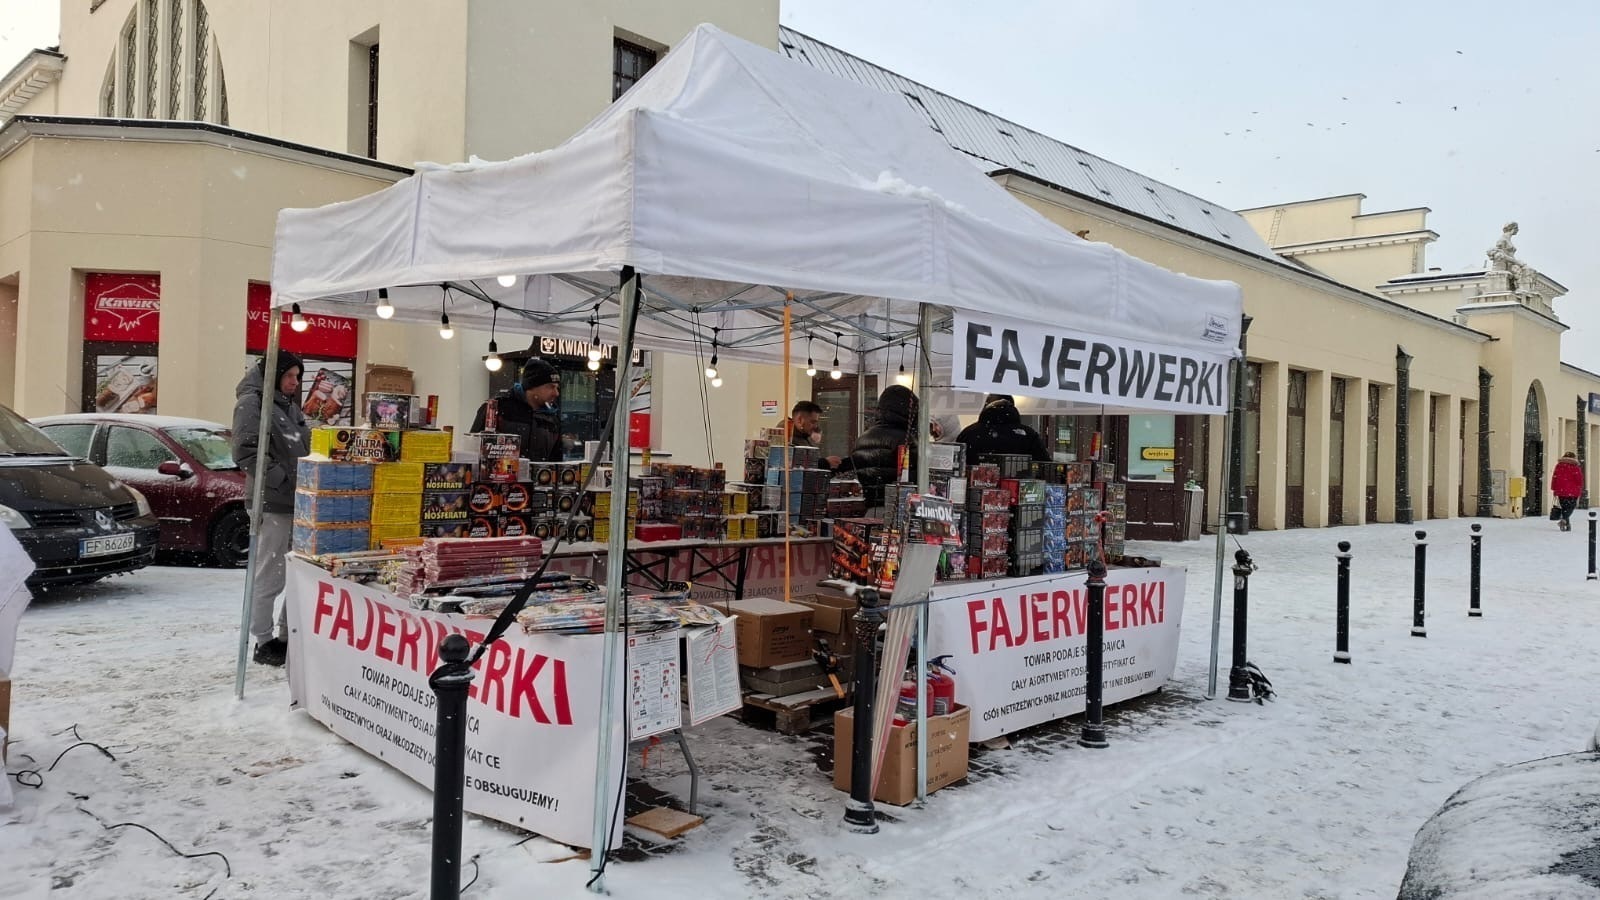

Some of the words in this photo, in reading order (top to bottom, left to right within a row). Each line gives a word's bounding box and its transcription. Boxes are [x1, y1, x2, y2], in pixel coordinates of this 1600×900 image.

[965, 321, 1222, 407] FAJERWERKI
[355, 437, 382, 448] ULTRA
[353, 448, 384, 458] ENERGY
[424, 511, 467, 520] NOSFERATU
[104, 536, 133, 550] 86269
[1024, 652, 1051, 667] TOWAR
[1052, 647, 1080, 662] PODAJE
[361, 665, 390, 690] TOWAR
[391, 678, 424, 705] PODAJE
[362, 692, 408, 722] ASORTYMENT
[485, 754, 501, 769] CE
[375, 724, 392, 742] ORAZ
[392, 732, 428, 762] MŁODZIEŻY
